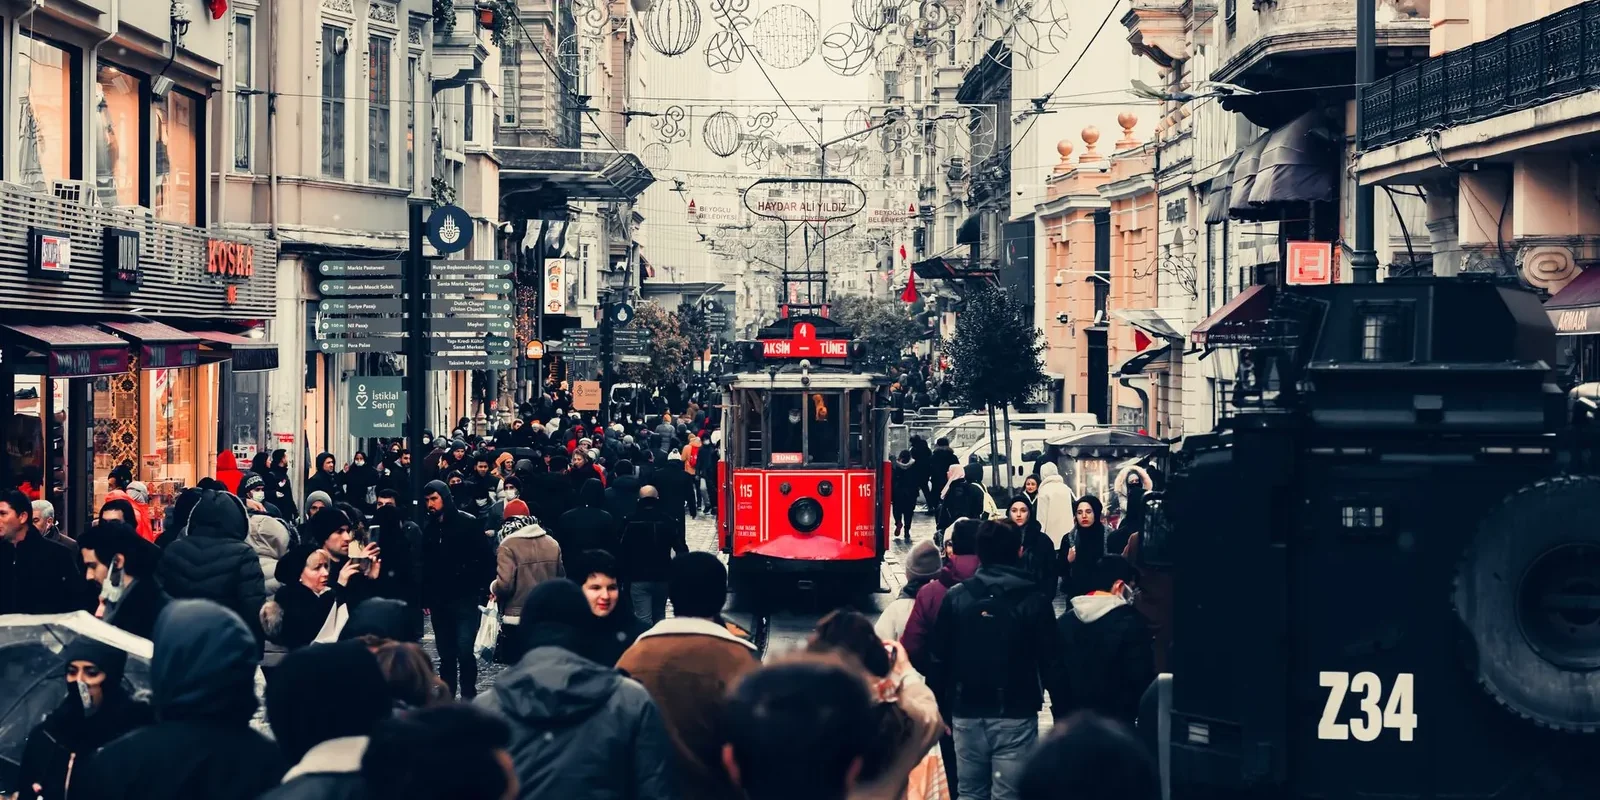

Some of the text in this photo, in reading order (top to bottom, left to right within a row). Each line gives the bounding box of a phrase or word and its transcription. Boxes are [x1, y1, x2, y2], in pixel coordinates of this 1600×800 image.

[758, 201, 847, 212] HAYDAR ALİ YILDIZ
[208, 239, 255, 276] KOSKA
[1557, 310, 1588, 331] ARMADA
[800, 324, 807, 337] 4
[763, 341, 847, 354] AKSİM TÜNEL
[372, 390, 399, 400] İstiklal
[372, 401, 395, 409] Senin
[740, 484, 753, 498] 115
[858, 483, 871, 497] 115
[1318, 671, 1418, 742] Z34
